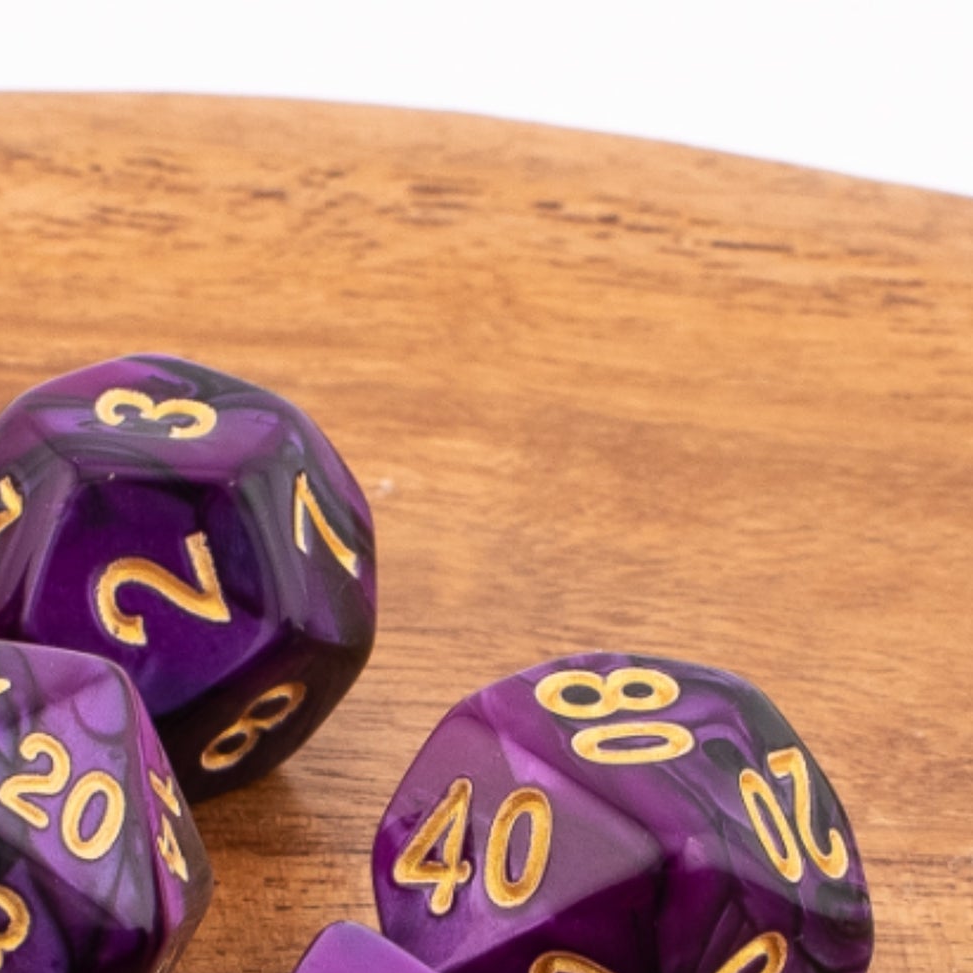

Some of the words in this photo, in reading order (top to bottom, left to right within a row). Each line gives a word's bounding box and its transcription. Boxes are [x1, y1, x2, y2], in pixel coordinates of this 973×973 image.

[95, 388, 217, 439] 3
[293, 471, 358, 577] 7
[97, 531, 231, 645] 2
[199, 681, 307, 772] 8
[534, 667, 695, 764] 80
[393, 778, 553, 915] 40
[738, 746, 849, 883] 20
